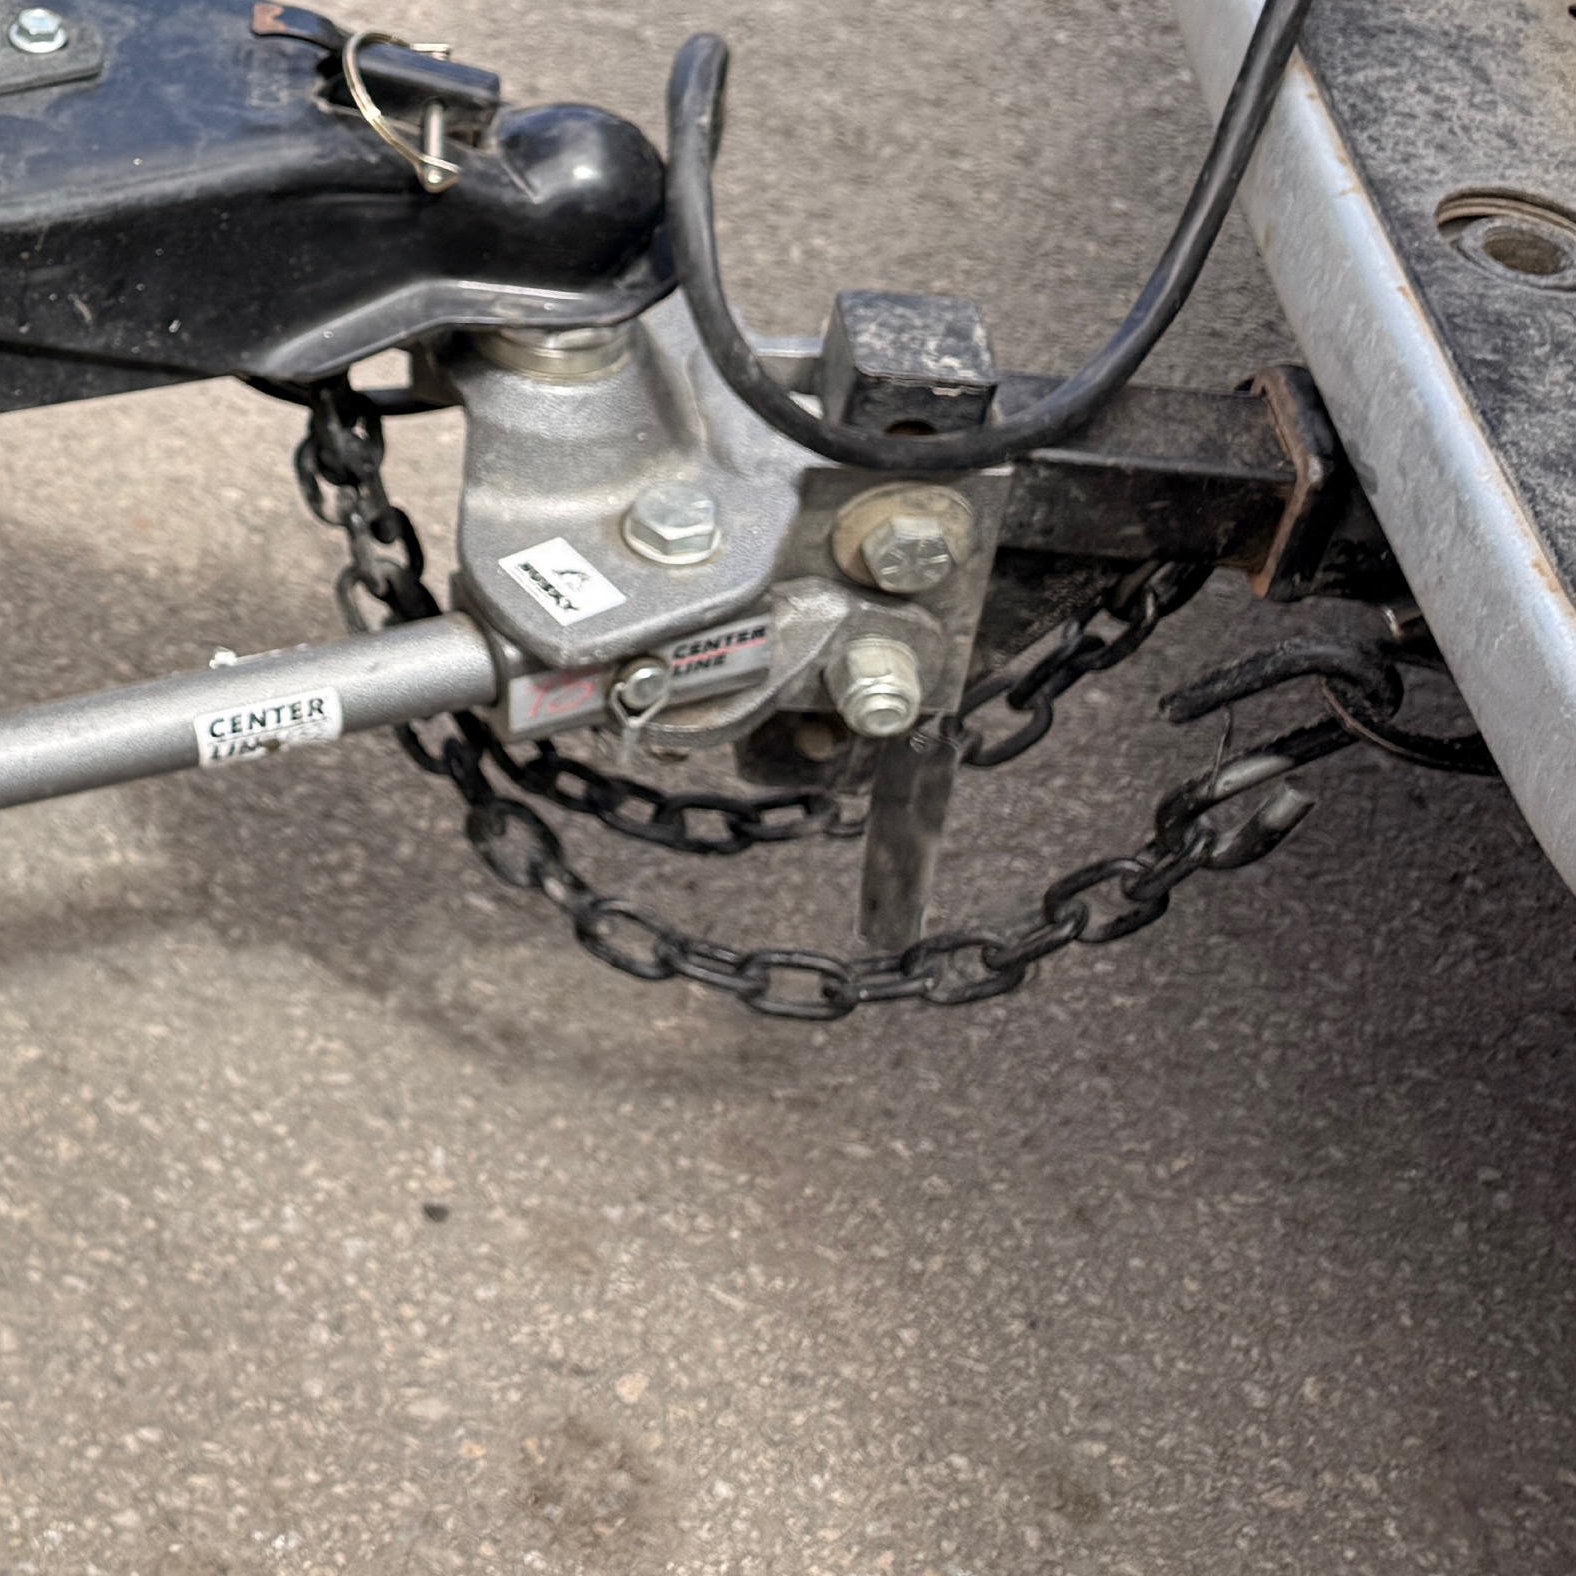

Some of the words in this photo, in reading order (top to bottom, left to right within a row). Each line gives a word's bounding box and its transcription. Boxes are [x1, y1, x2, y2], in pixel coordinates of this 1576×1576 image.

[674, 626, 767, 660] CENTER
[672, 654, 727, 676] LINE
[209, 698, 325, 738] CENTER
